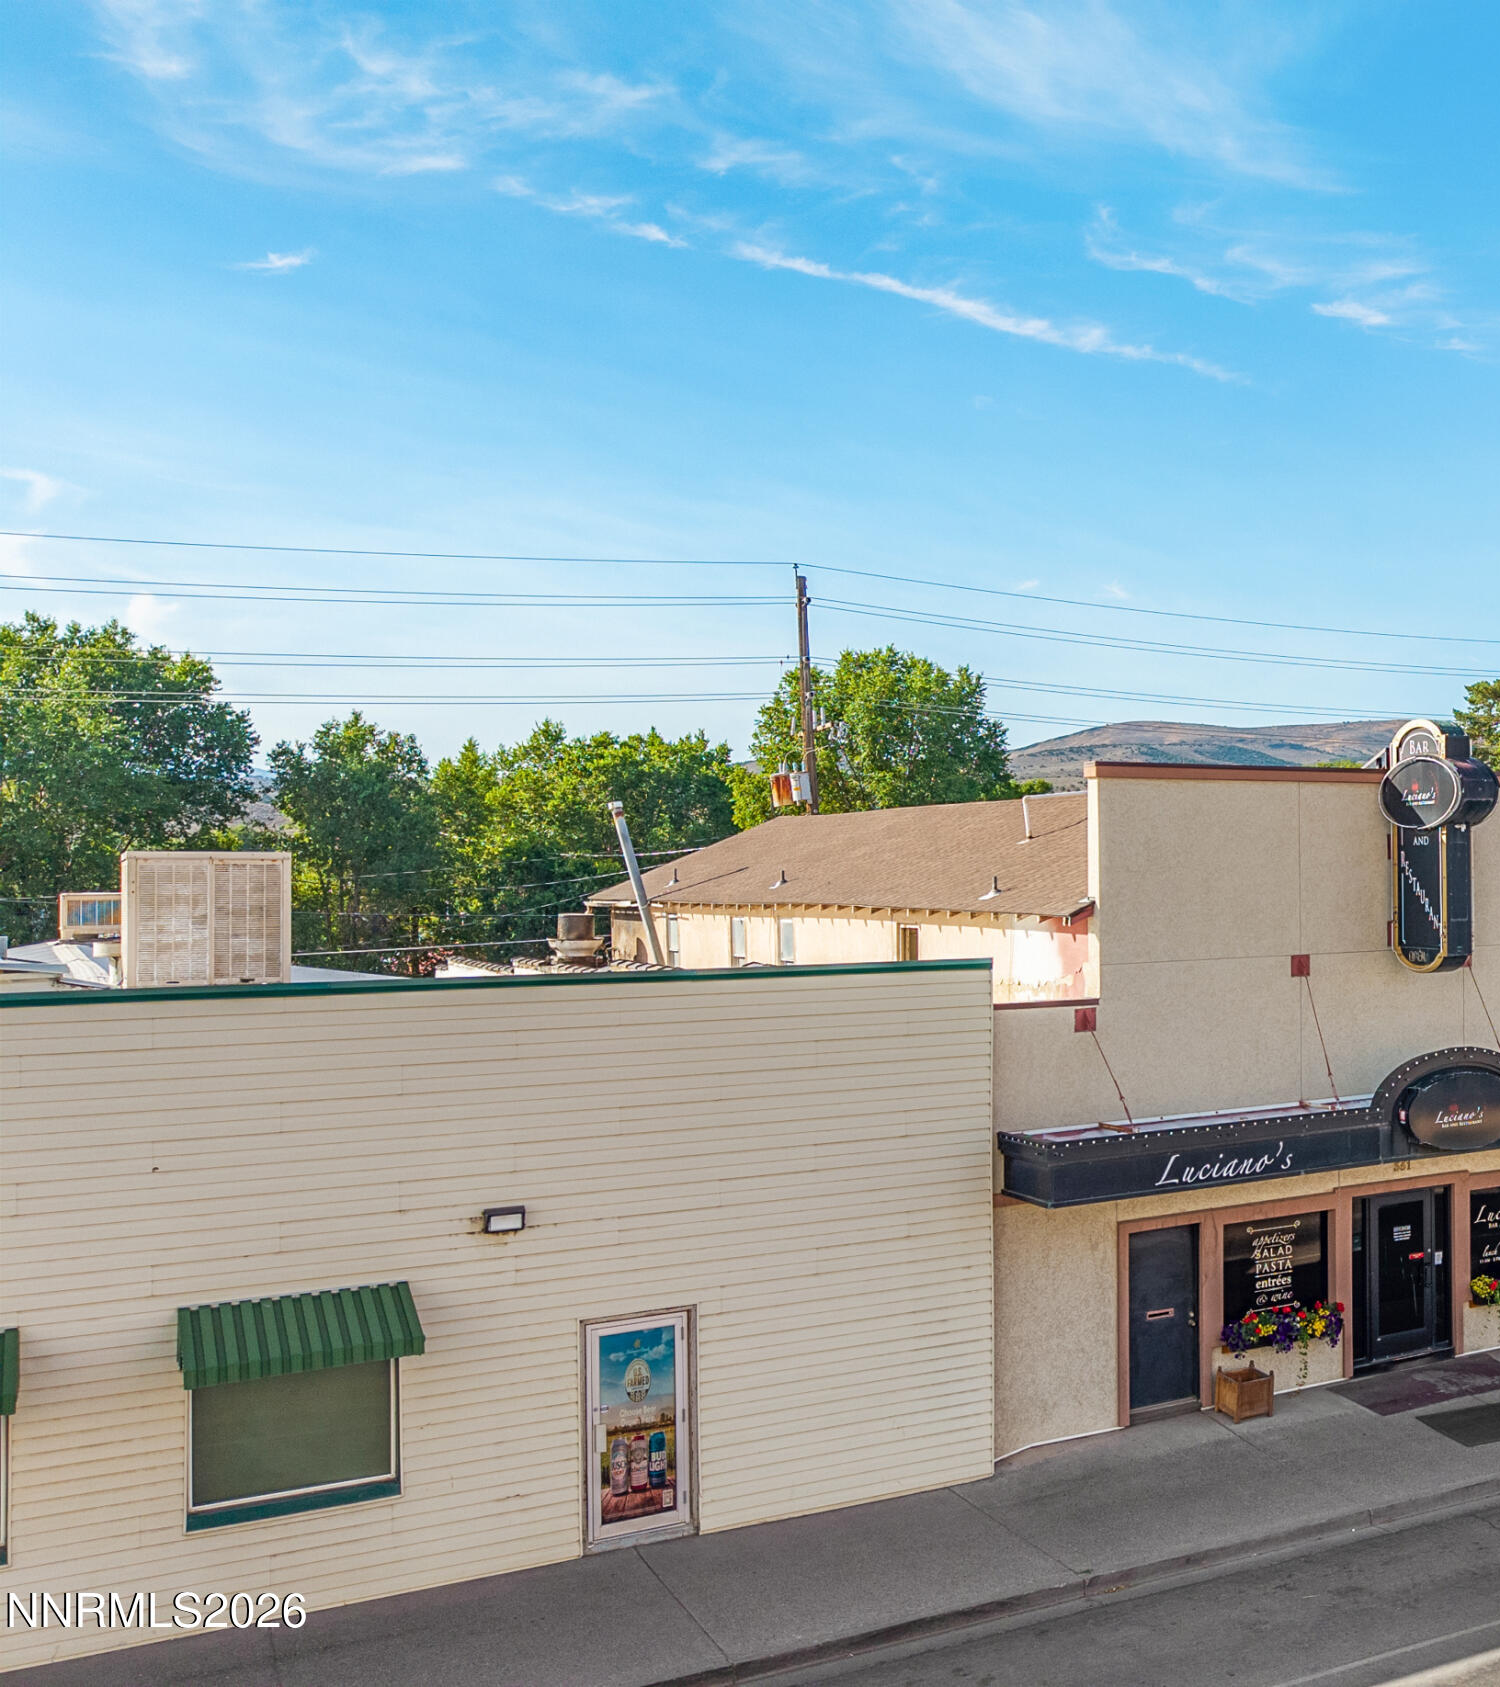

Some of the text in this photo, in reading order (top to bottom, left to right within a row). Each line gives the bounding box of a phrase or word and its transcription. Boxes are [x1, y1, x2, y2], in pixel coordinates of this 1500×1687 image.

[1409, 740, 1430, 754] BAR
[1412, 835, 1430, 846] AND
[1434, 1106, 1485, 1124] Luciano's
[1154, 1140, 1294, 1187] Luciano's
[1250, 1232, 1297, 1259] appetizers
[1254, 1245, 1293, 1260] SALAD
[1255, 1260, 1293, 1274] PASTA
[1255, 1275, 1293, 1290] entrées
[1270, 1289, 1295, 1302] wine
